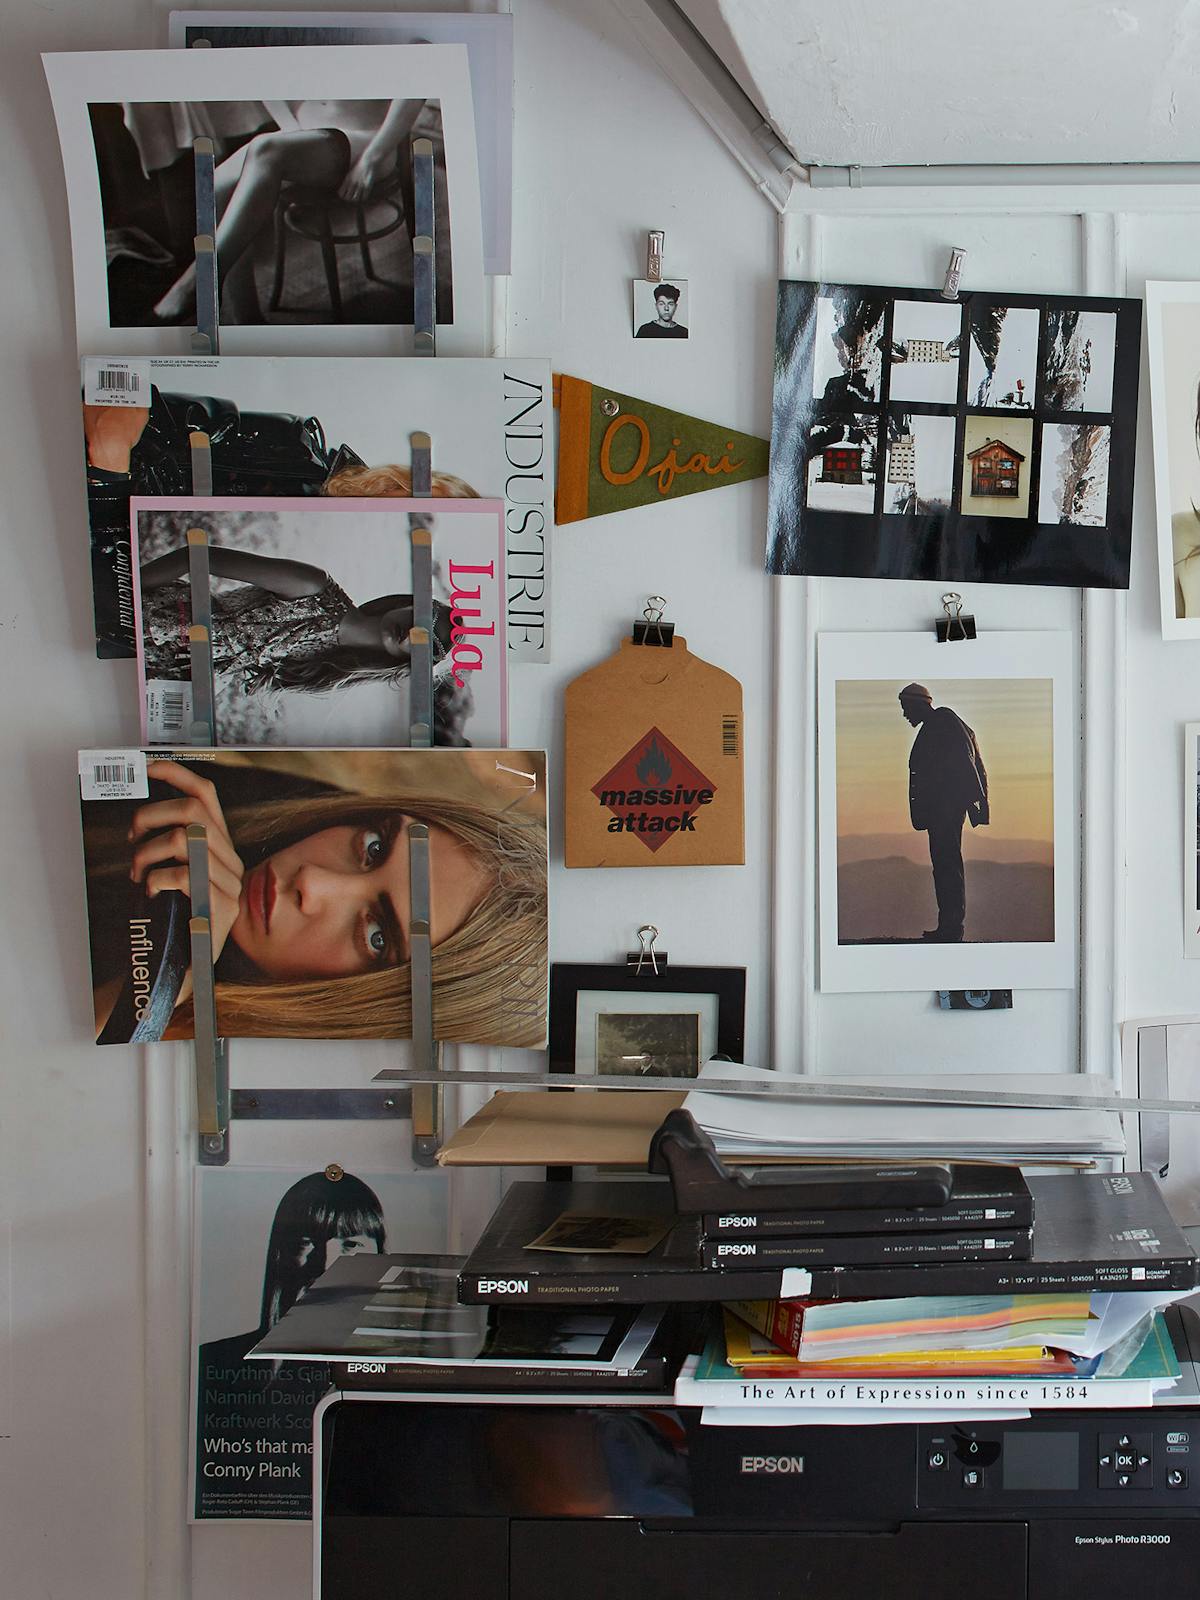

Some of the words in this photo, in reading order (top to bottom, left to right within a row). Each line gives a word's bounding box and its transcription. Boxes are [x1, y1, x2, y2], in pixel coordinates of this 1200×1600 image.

[600, 414, 747, 495] Ojai
[503, 372, 545, 652] INDUSTRIE
[447, 559, 495, 689] Lula
[599, 784, 714, 806] massive
[607, 811, 699, 833] attack
[718, 1216, 756, 1228] EPSON
[718, 1244, 756, 1256] EPSON
[477, 1279, 529, 1294] EPSON
[205, 1365, 294, 1385] Eurythmics
[347, 1362, 386, 1374] EPSON
[205, 1390, 267, 1405] Nannini
[271, 1390, 317, 1405] David
[740, 1385, 775, 1400] The
[784, 1385, 816, 1400] Art
[826, 1385, 847, 1400] of
[856, 1385, 967, 1403] Expression
[976, 1385, 1030, 1400] since
[1040, 1385, 1089, 1400] 1584
[205, 1413, 281, 1430] Kraftwerk
[203, 1438, 252, 1454] Who's
[255, 1438, 288, 1454] that
[740, 1456, 804, 1475] EPSON
[1118, 1456, 1132, 1465] OK
[203, 1462, 255, 1481] Conny
[258, 1462, 302, 1478] Plank
[1075, 1536, 1094, 1544] Epson
[1094, 1536, 1114, 1544] Stylus
[1115, 1535, 1140, 1544] Photo
[1140, 1535, 1170, 1544] R3000
